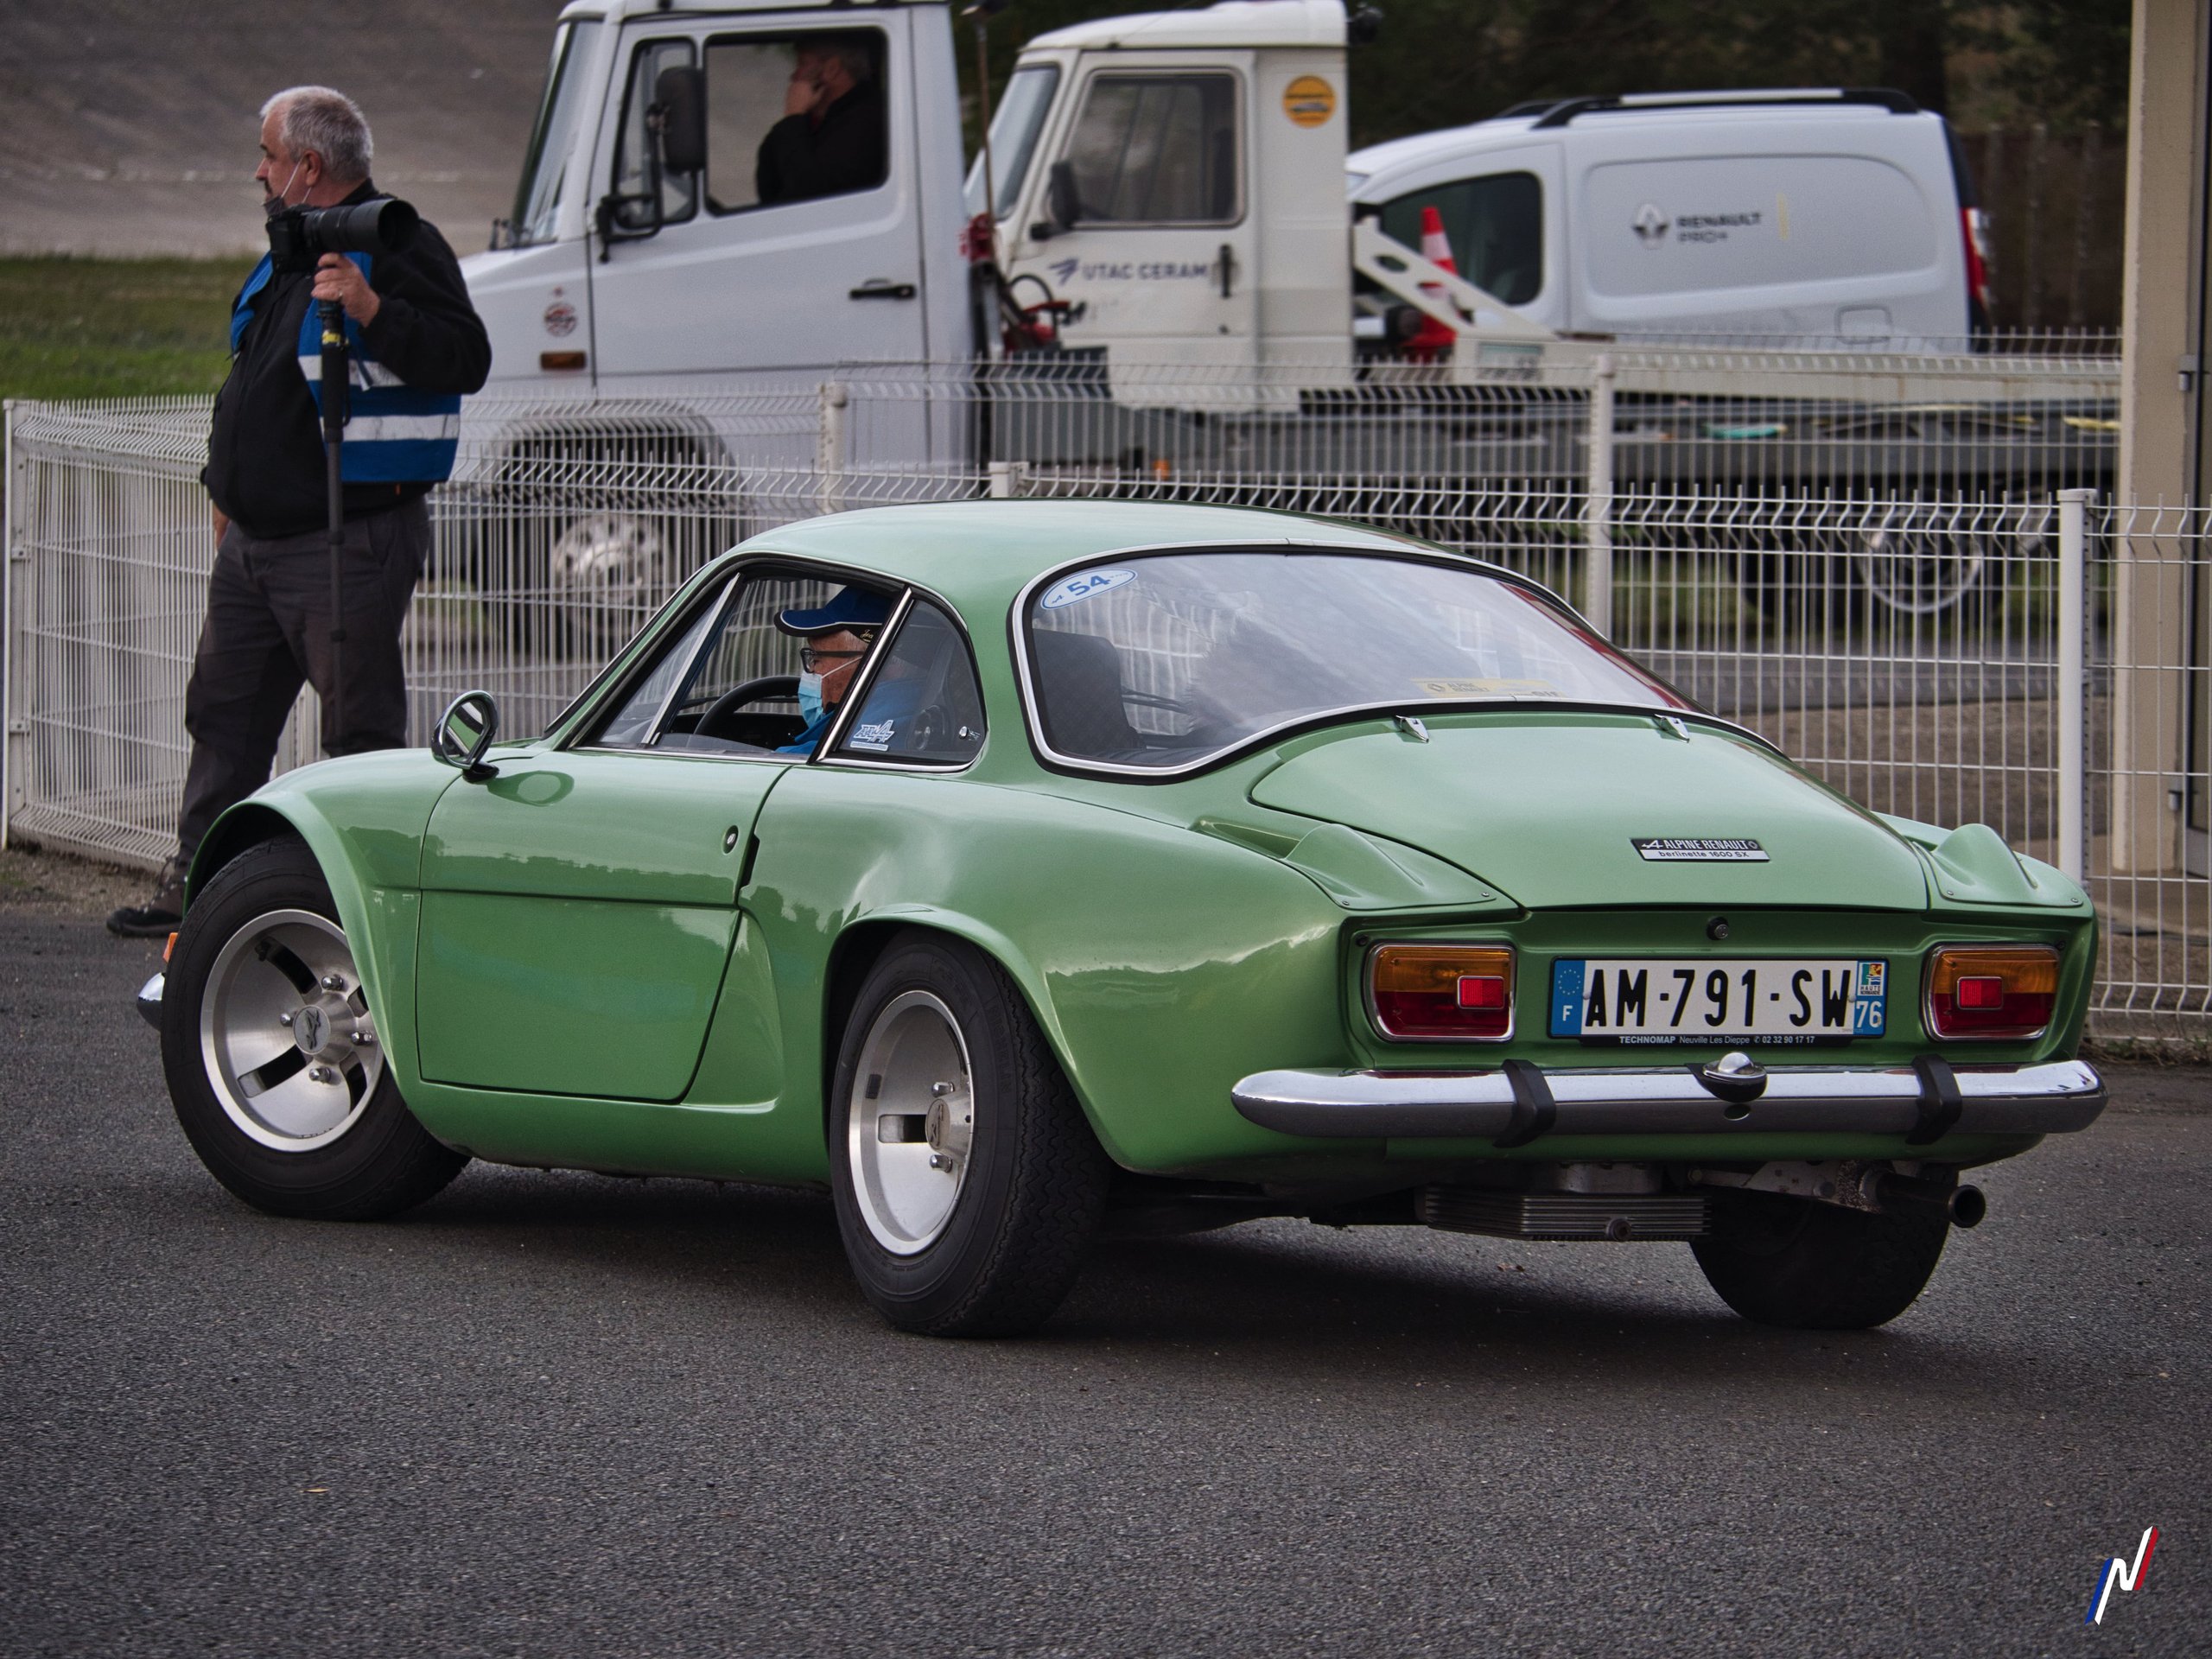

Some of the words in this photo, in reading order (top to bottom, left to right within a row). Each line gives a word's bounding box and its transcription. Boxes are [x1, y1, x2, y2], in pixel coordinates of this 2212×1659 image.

[1678, 213, 1760, 228] RENAULT
[1083, 263, 1134, 280] UTAC
[1139, 262, 1207, 280] CERAM
[1066, 575, 1111, 596] 54
[1663, 840, 1701, 849] ALPINE
[1701, 840, 1749, 849] RENAULT
[1562, 1005, 1573, 1021] F
[1856, 1001, 1883, 1028] 76
[1619, 1035, 1675, 1044] TECHNOMAP
[1725, 1036, 1750, 1046] Dieppe
